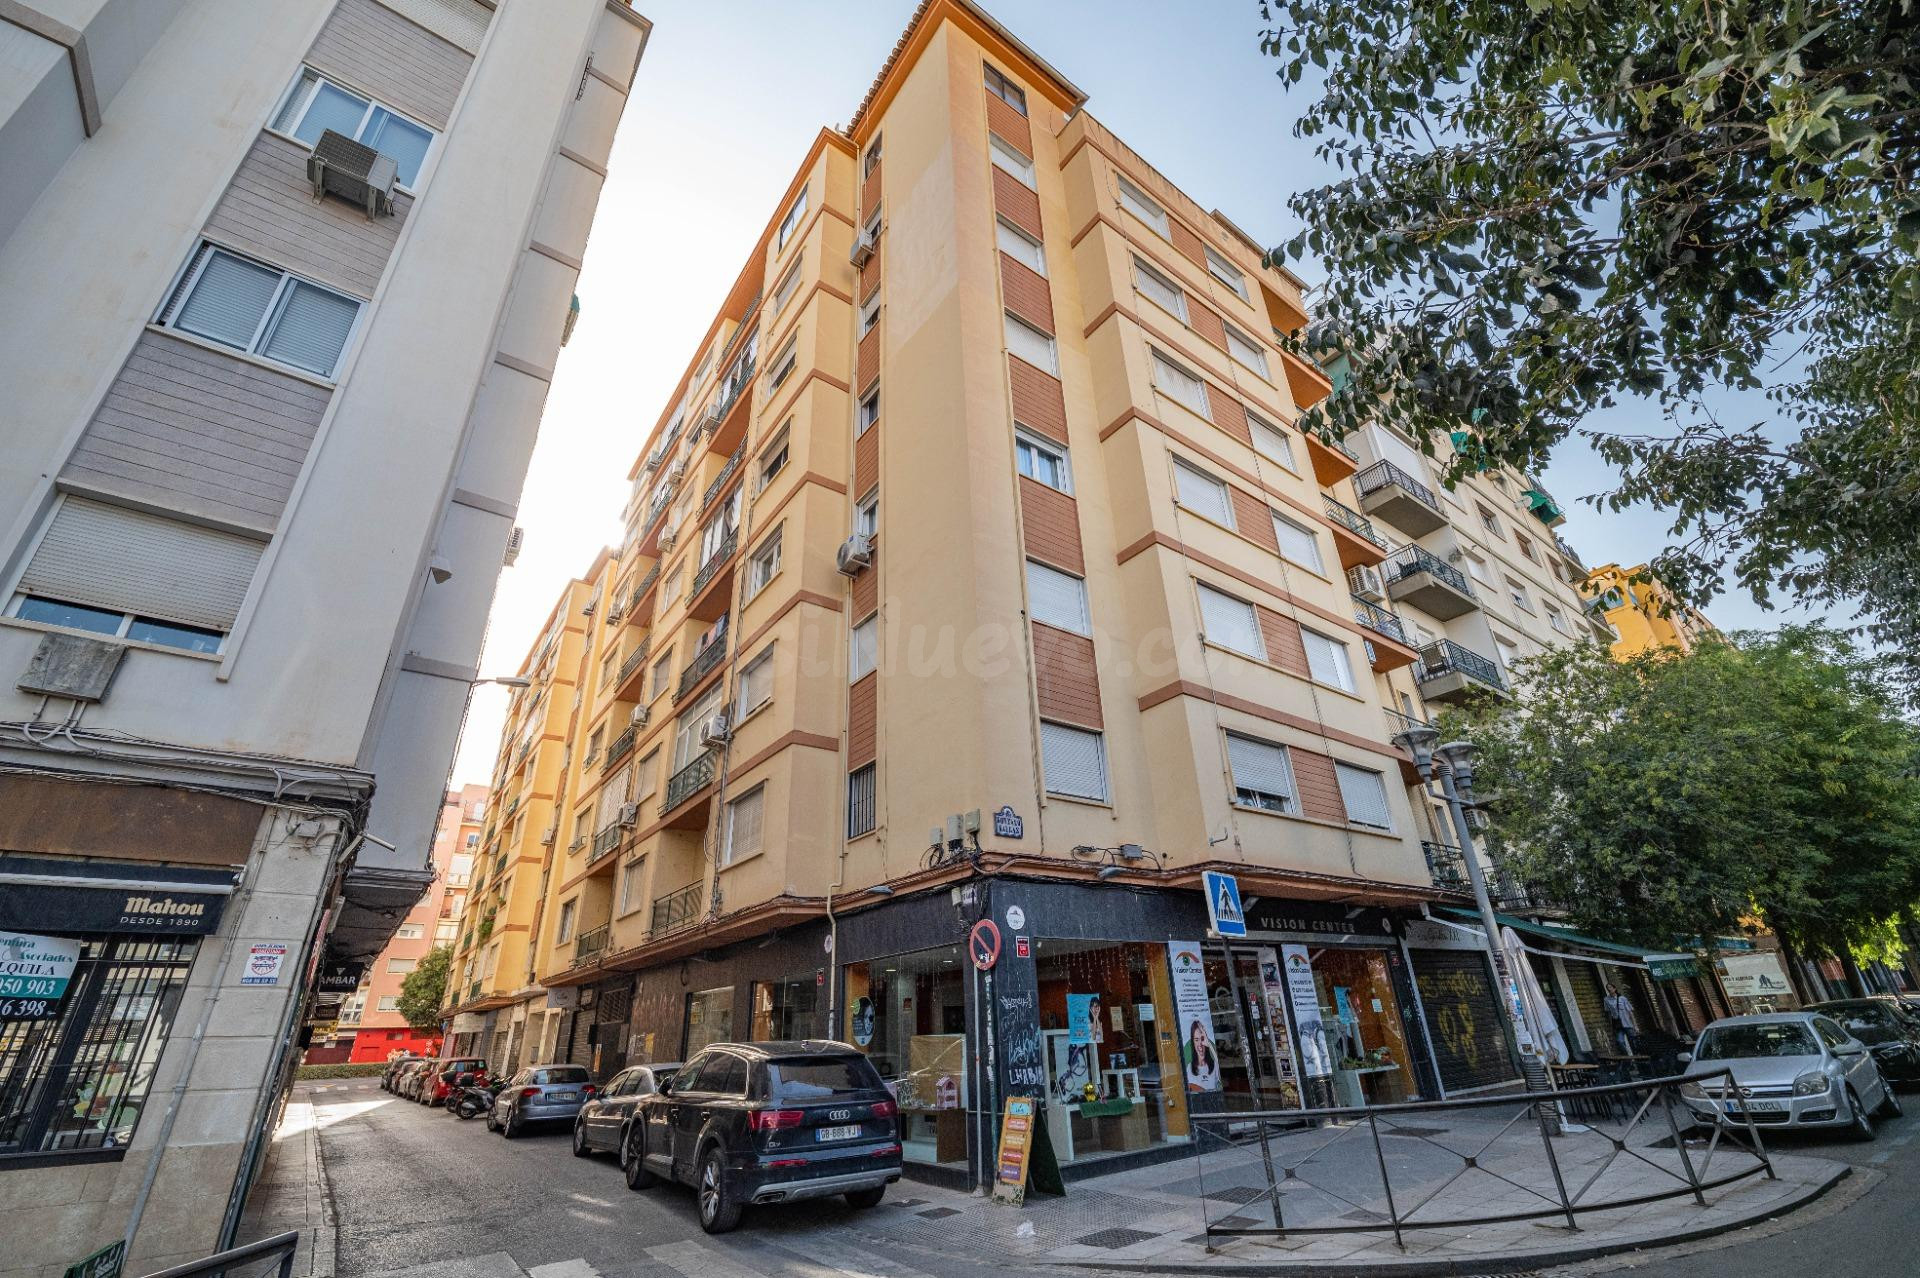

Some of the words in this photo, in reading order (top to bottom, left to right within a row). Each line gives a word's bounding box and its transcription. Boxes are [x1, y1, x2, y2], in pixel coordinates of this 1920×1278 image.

[124, 897, 205, 916] Mahou
[120, 916, 163, 926] DESDE
[169, 918, 199, 927] 1890
[1260, 917, 1306, 930] VISION
[1312, 920, 1355, 934] CENTER
[25, 979, 56, 995] 903
[319, 975, 356, 985] AMBAR
[14, 1000, 47, 1017] 398
